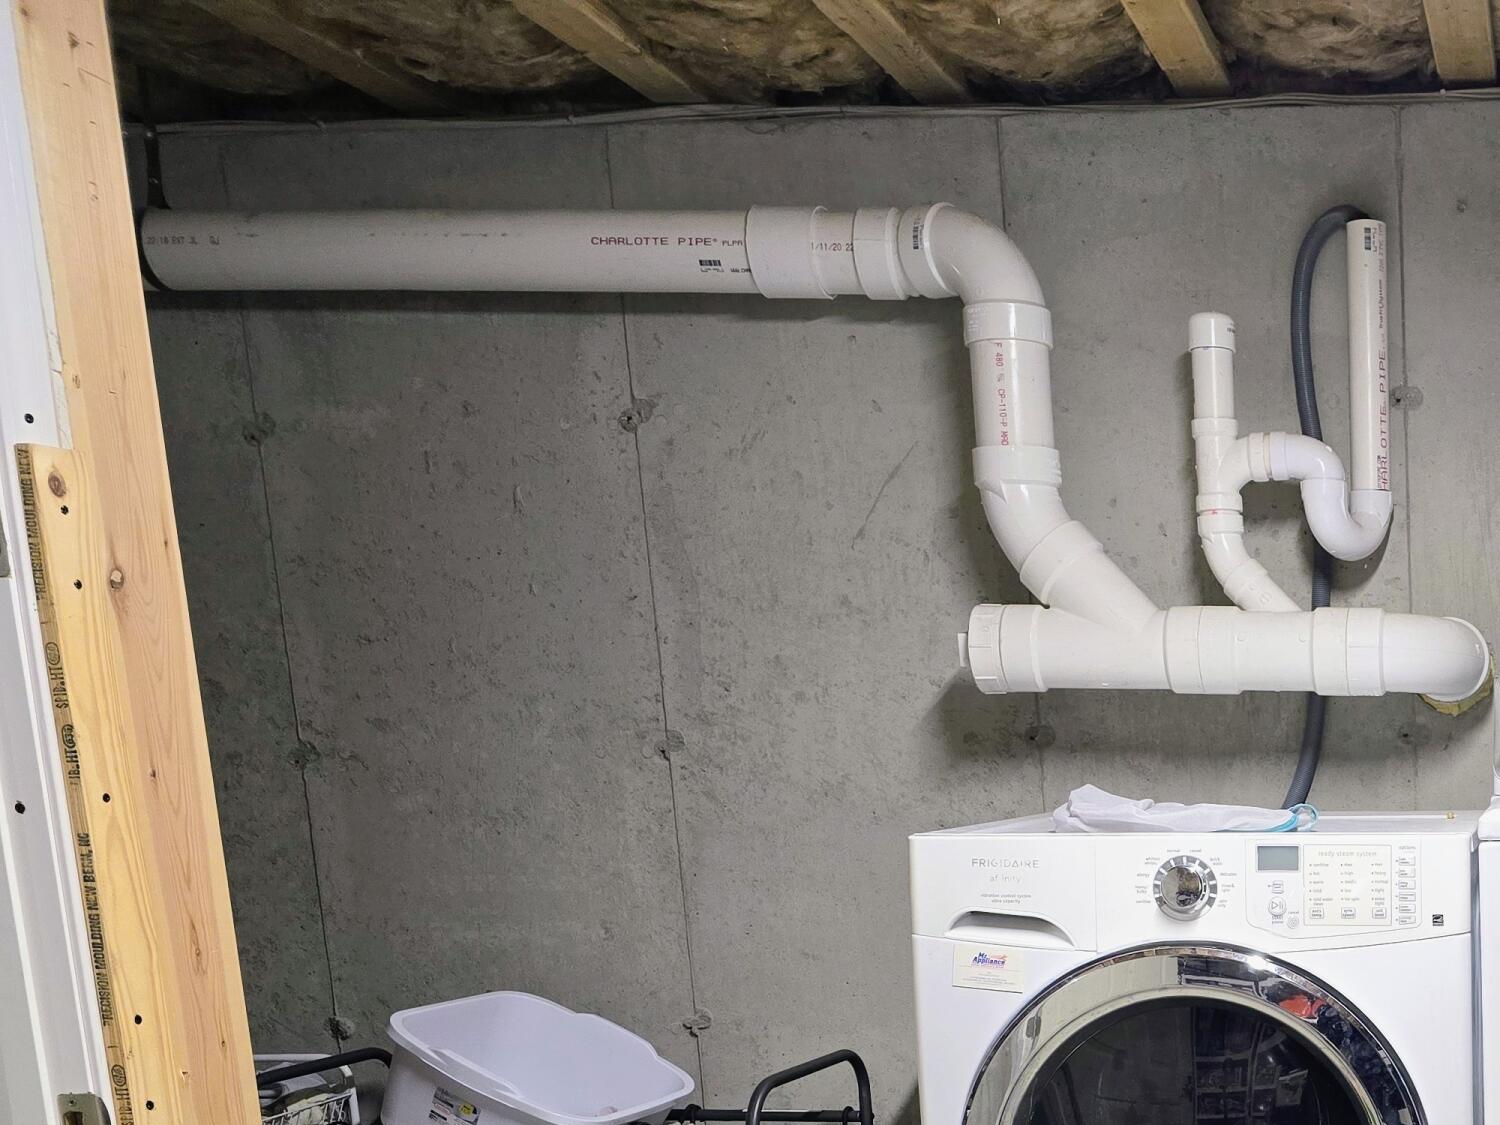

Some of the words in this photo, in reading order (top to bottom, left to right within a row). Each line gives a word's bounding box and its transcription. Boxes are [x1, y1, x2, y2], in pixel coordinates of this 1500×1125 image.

[590, 236, 669, 246] CHARLOTTE
[995, 352, 1004, 367] 480
[17, 448, 32, 476] NEW
[20, 478, 39, 540] MOULDING
[77, 832, 91, 848] NC
[971, 858, 1040, 869] FRIGIDAIRE
[84, 884, 100, 911] NEW
[89, 914, 107, 970] MOULDING
[95, 968, 114, 1027] PRECISION
